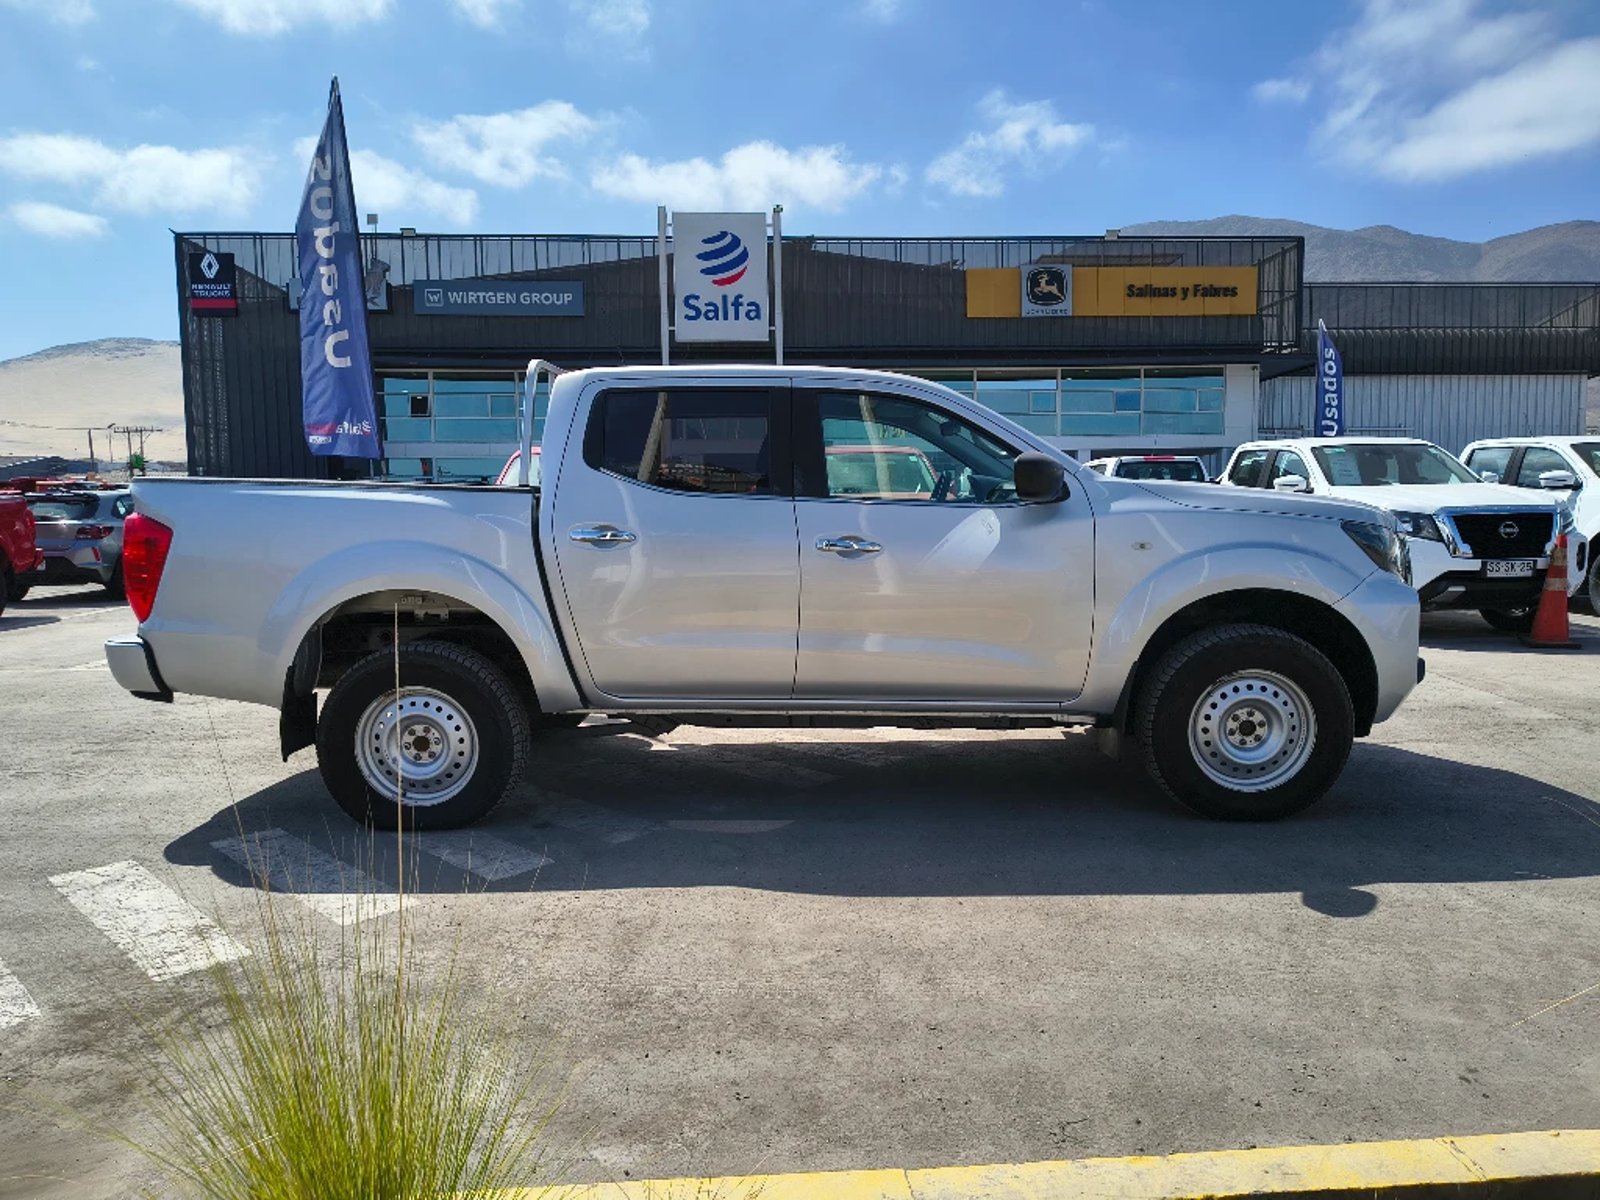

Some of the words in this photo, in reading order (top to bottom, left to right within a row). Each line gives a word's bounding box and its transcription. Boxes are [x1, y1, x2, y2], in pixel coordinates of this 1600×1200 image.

[448, 291, 517, 304] WIRTGEN
[520, 293, 573, 305] GROUP
[1126, 284, 1178, 298] Salinas
[1181, 286, 1190, 301] y
[1193, 284, 1238, 298] Fabres
[683, 293, 761, 321] Salfa
[1321, 348, 1339, 437] Usados
